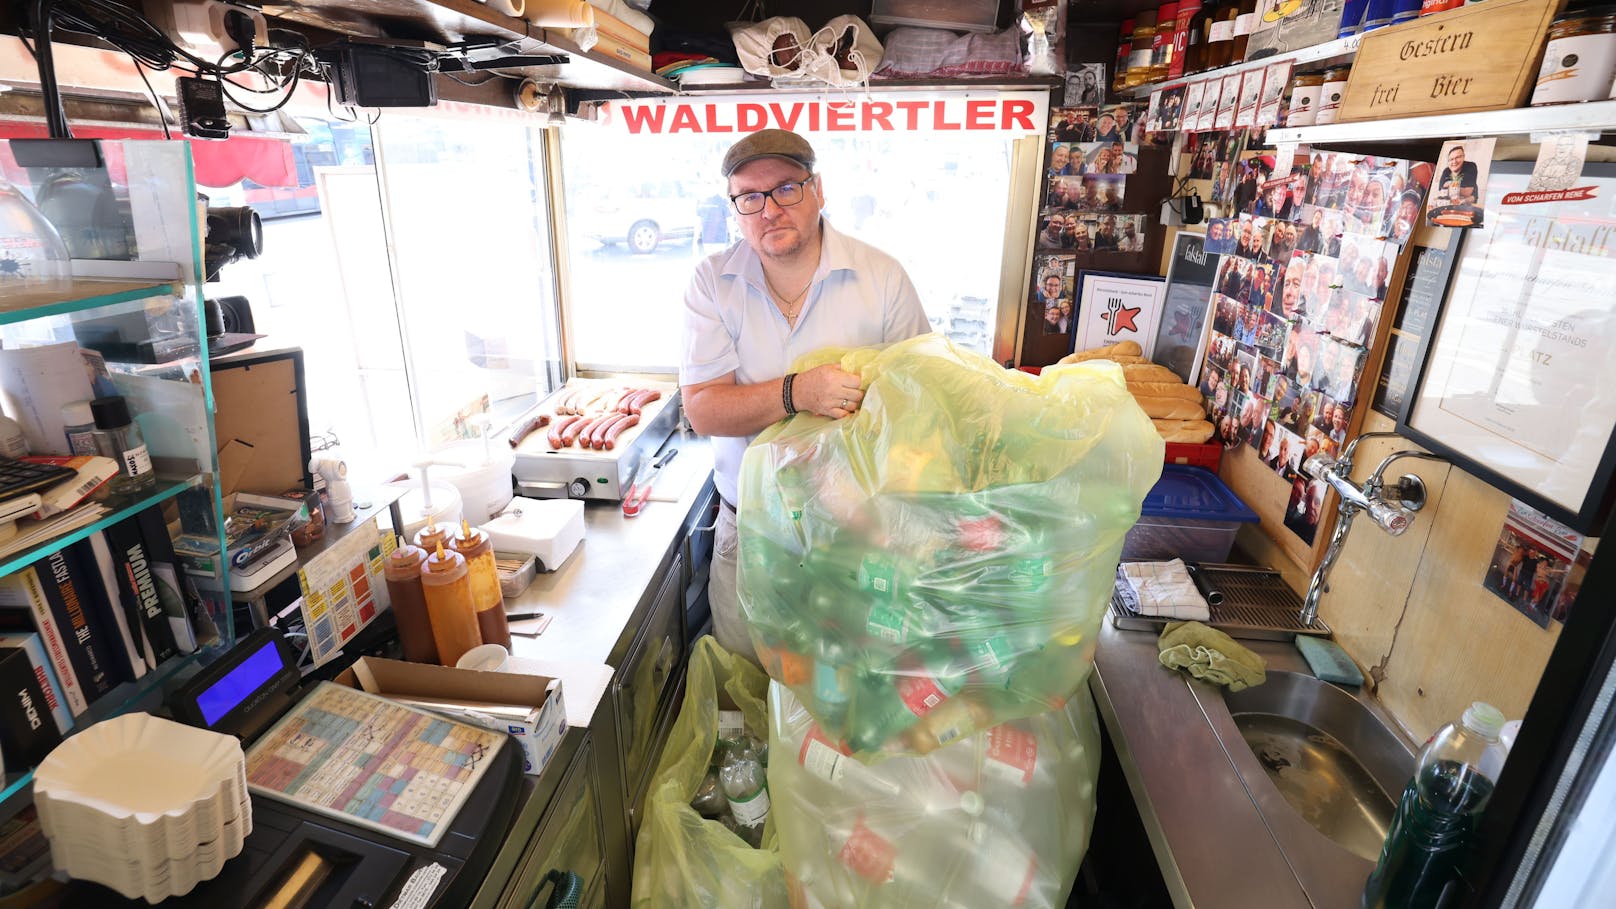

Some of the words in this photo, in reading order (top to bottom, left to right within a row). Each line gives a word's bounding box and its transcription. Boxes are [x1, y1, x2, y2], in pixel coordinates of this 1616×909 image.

[1399, 30, 1474, 62] Gestern
[1372, 84, 1400, 108] frei
[1430, 75, 1474, 99] Bier
[622, 99, 1037, 135] WALDVIERTLER
[1506, 195, 1524, 204] VOM
[1524, 191, 1565, 203] SCHARFEN
[235, 537, 271, 566] Orbit
[50, 552, 70, 583] FASTLA
[127, 544, 161, 618] PREMIUM
[75, 625, 92, 645] THE
[34, 664, 60, 712] RHETORIK
[18, 687, 43, 731] DENIM
